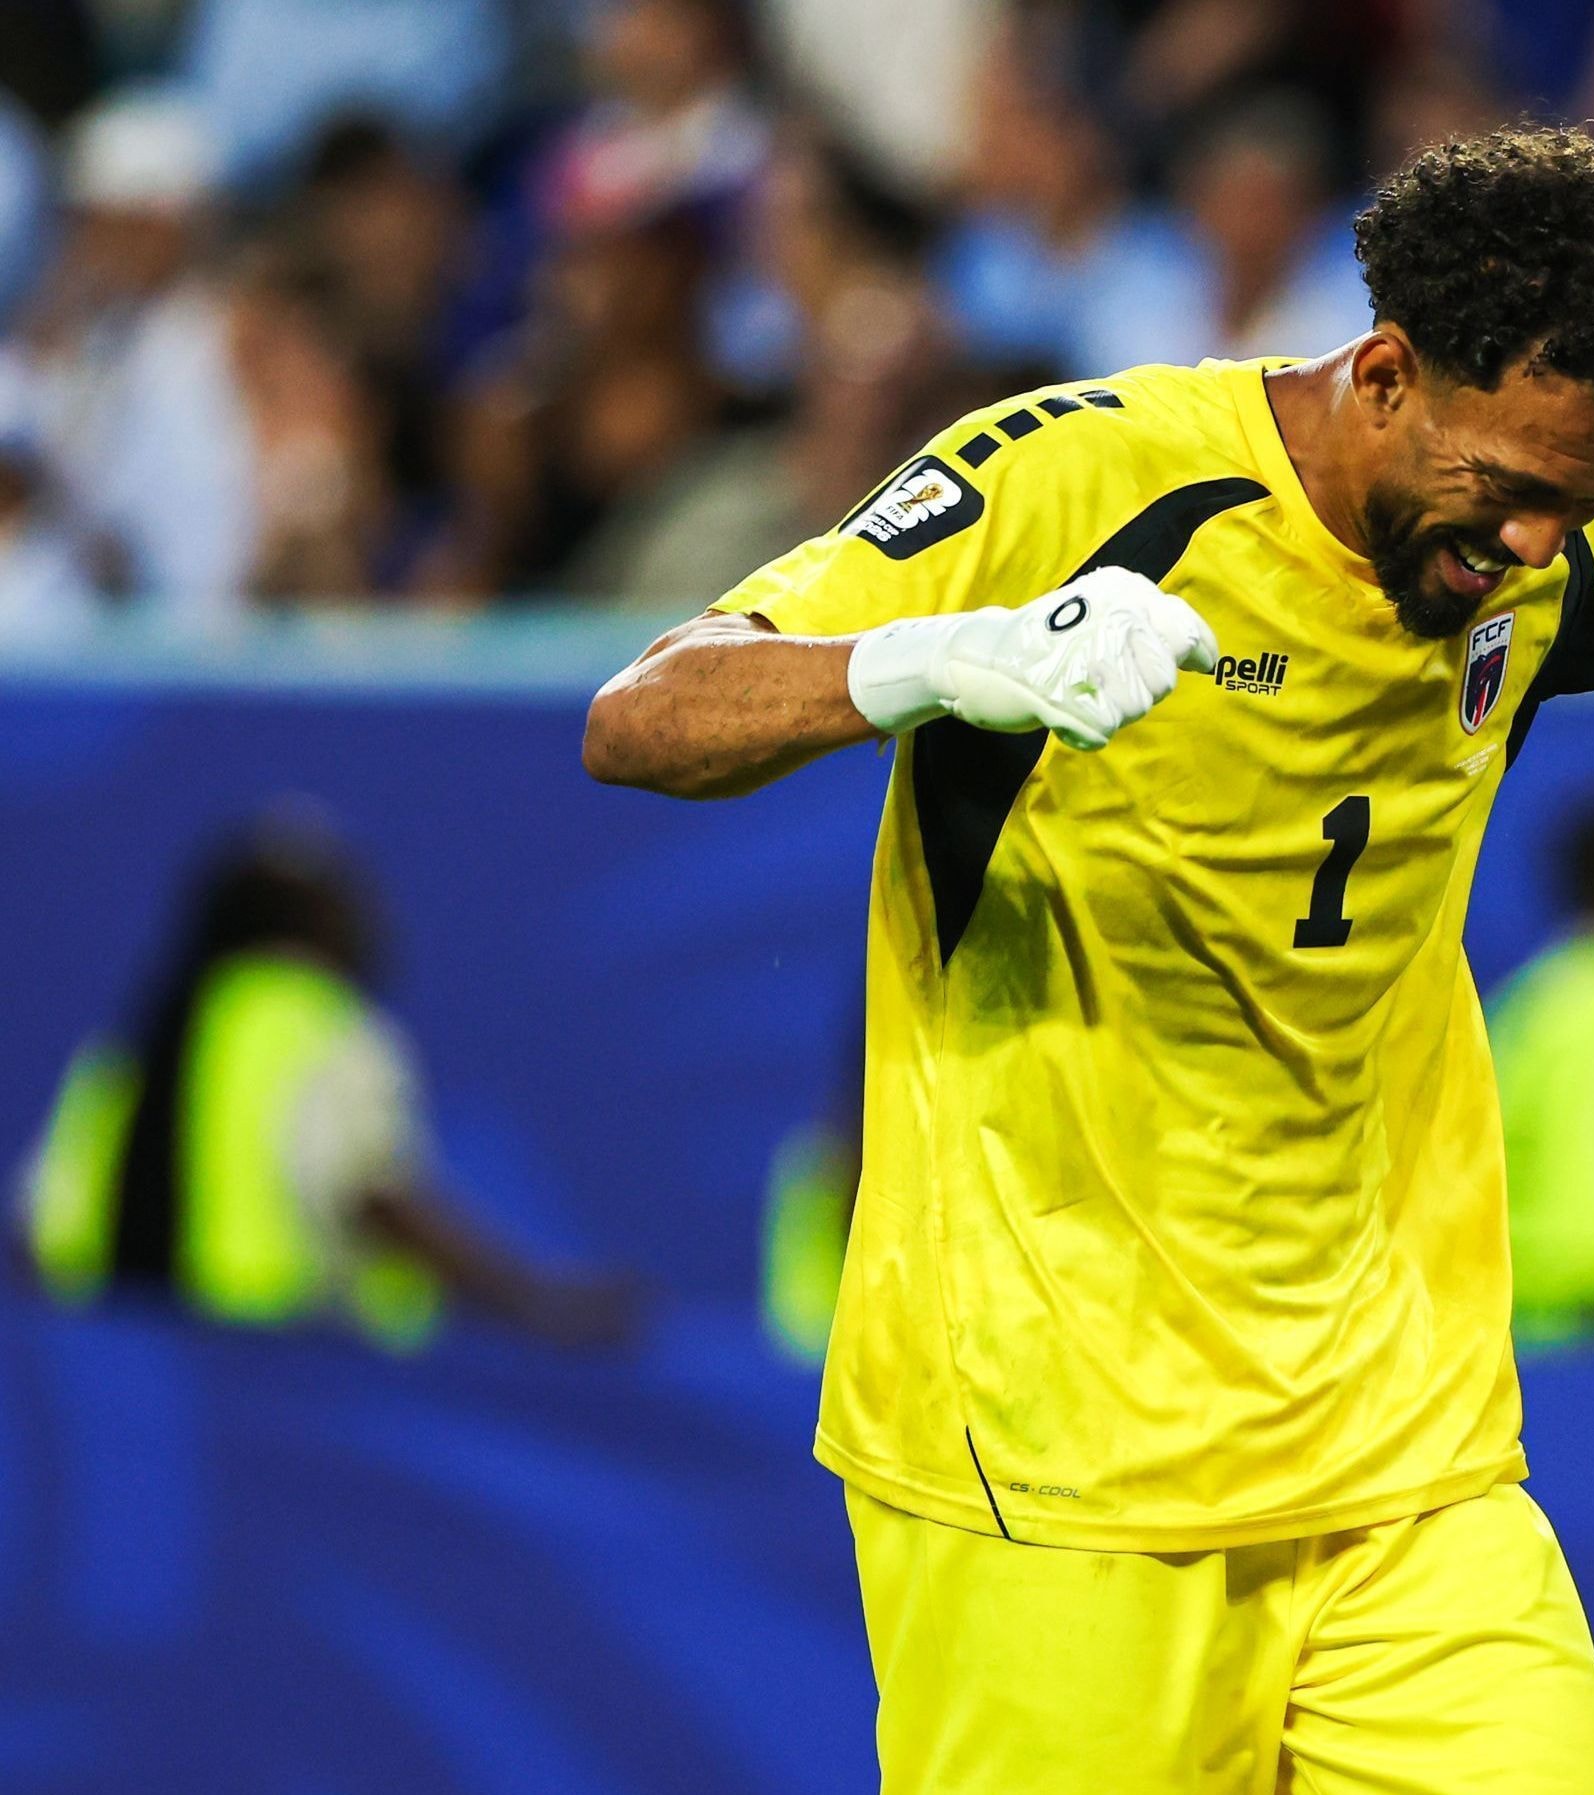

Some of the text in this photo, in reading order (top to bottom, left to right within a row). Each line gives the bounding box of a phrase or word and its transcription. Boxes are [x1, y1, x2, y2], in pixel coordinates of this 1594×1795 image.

[1472, 618, 1511, 651] FCF
[1208, 652, 1289, 686] pelli
[1225, 680, 1282, 696] SPORT
[1293, 795, 1370, 948] 1
